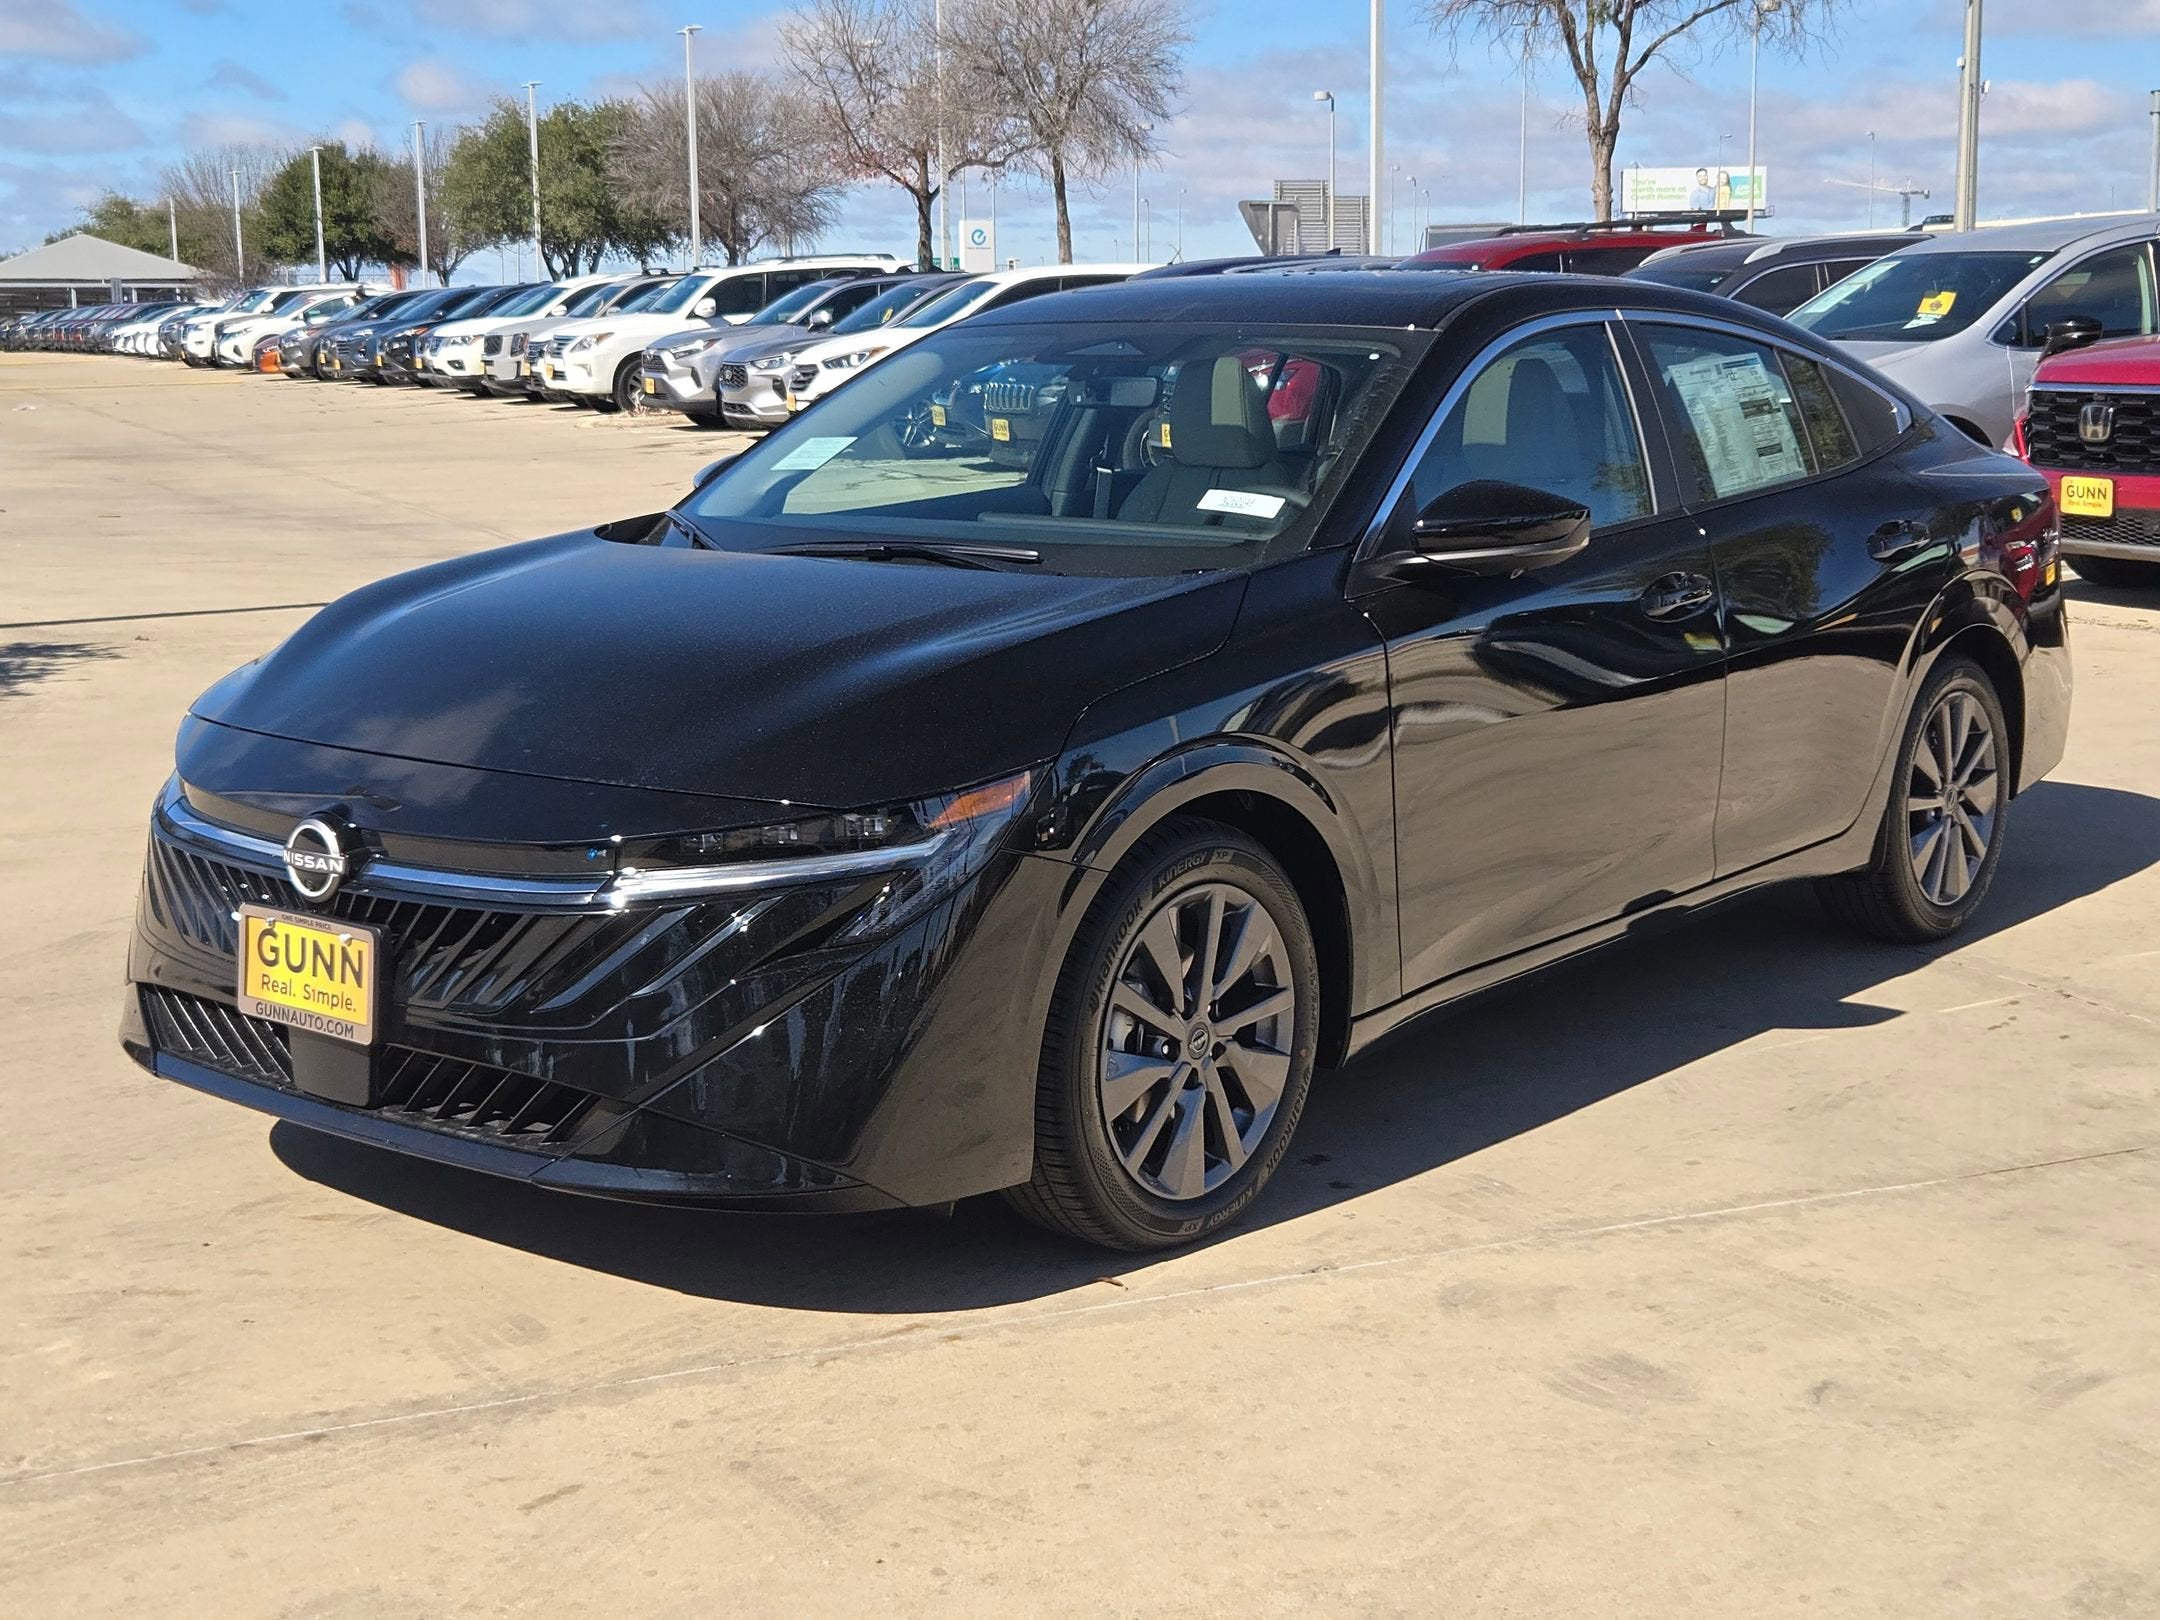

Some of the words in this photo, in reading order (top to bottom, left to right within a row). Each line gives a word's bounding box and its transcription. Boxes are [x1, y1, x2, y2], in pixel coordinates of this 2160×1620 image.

[2066, 484, 2107, 500] GUNN
[283, 849, 343, 873] NISSAN
[1158, 851, 1208, 888] KINERGY
[1215, 849, 1230, 860] XP
[281, 914, 294, 922] ONE
[294, 916, 314, 927] SIMPLE
[315, 921, 332, 931] PRICE
[257, 927, 364, 988] GUNN
[261, 974, 296, 998] Real.
[303, 983, 357, 1013] Simple.
[255, 1001, 354, 1039] GUNNAUTO.COM
[1206, 1188, 1253, 1228] KINERGY
